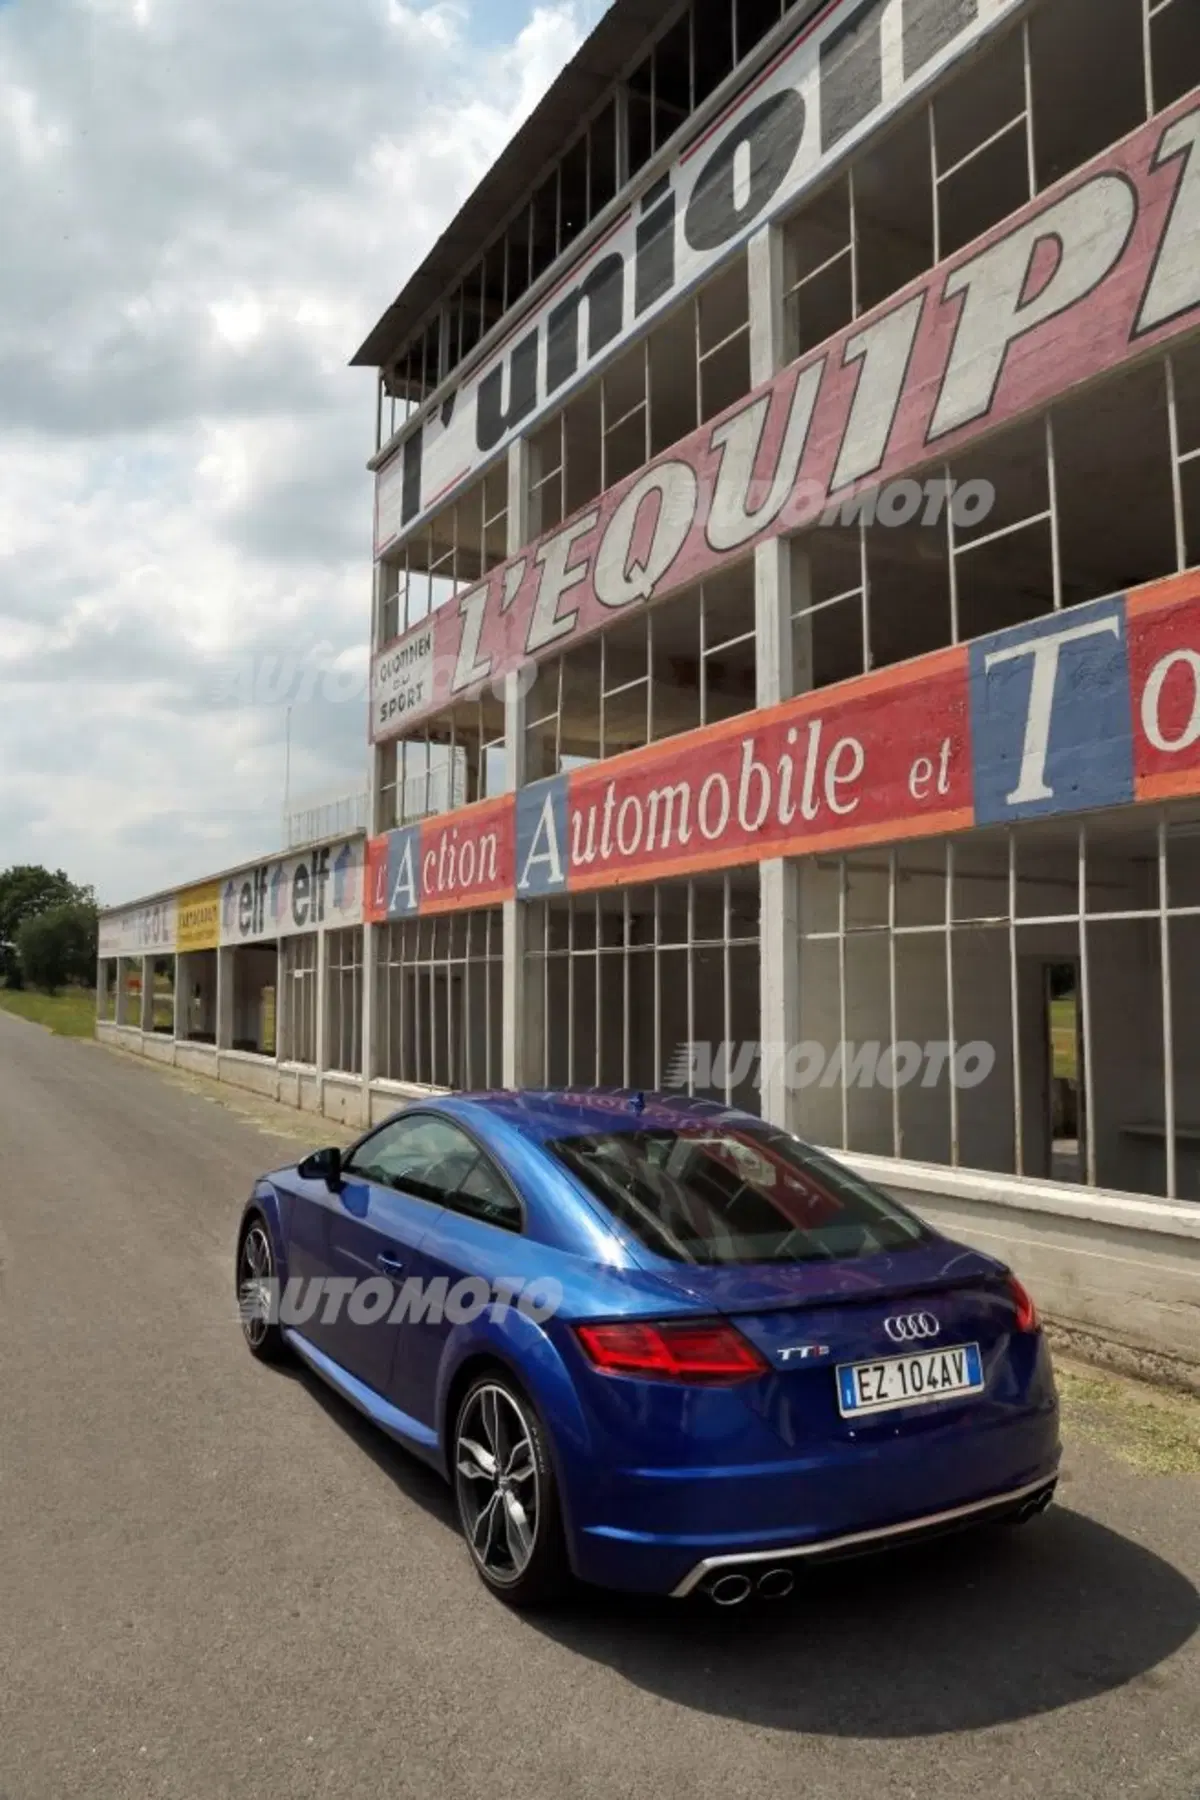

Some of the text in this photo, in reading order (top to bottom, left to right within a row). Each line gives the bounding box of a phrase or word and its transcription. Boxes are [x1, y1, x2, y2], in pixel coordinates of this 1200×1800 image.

[379, 681, 424, 723] SPORT
[517, 718, 865, 890] Automobile
[908, 737, 952, 800] et
[239, 865, 268, 938] elf
[292, 846, 331, 927] elf
[857, 1351, 964, 1402] EZ 104AV
